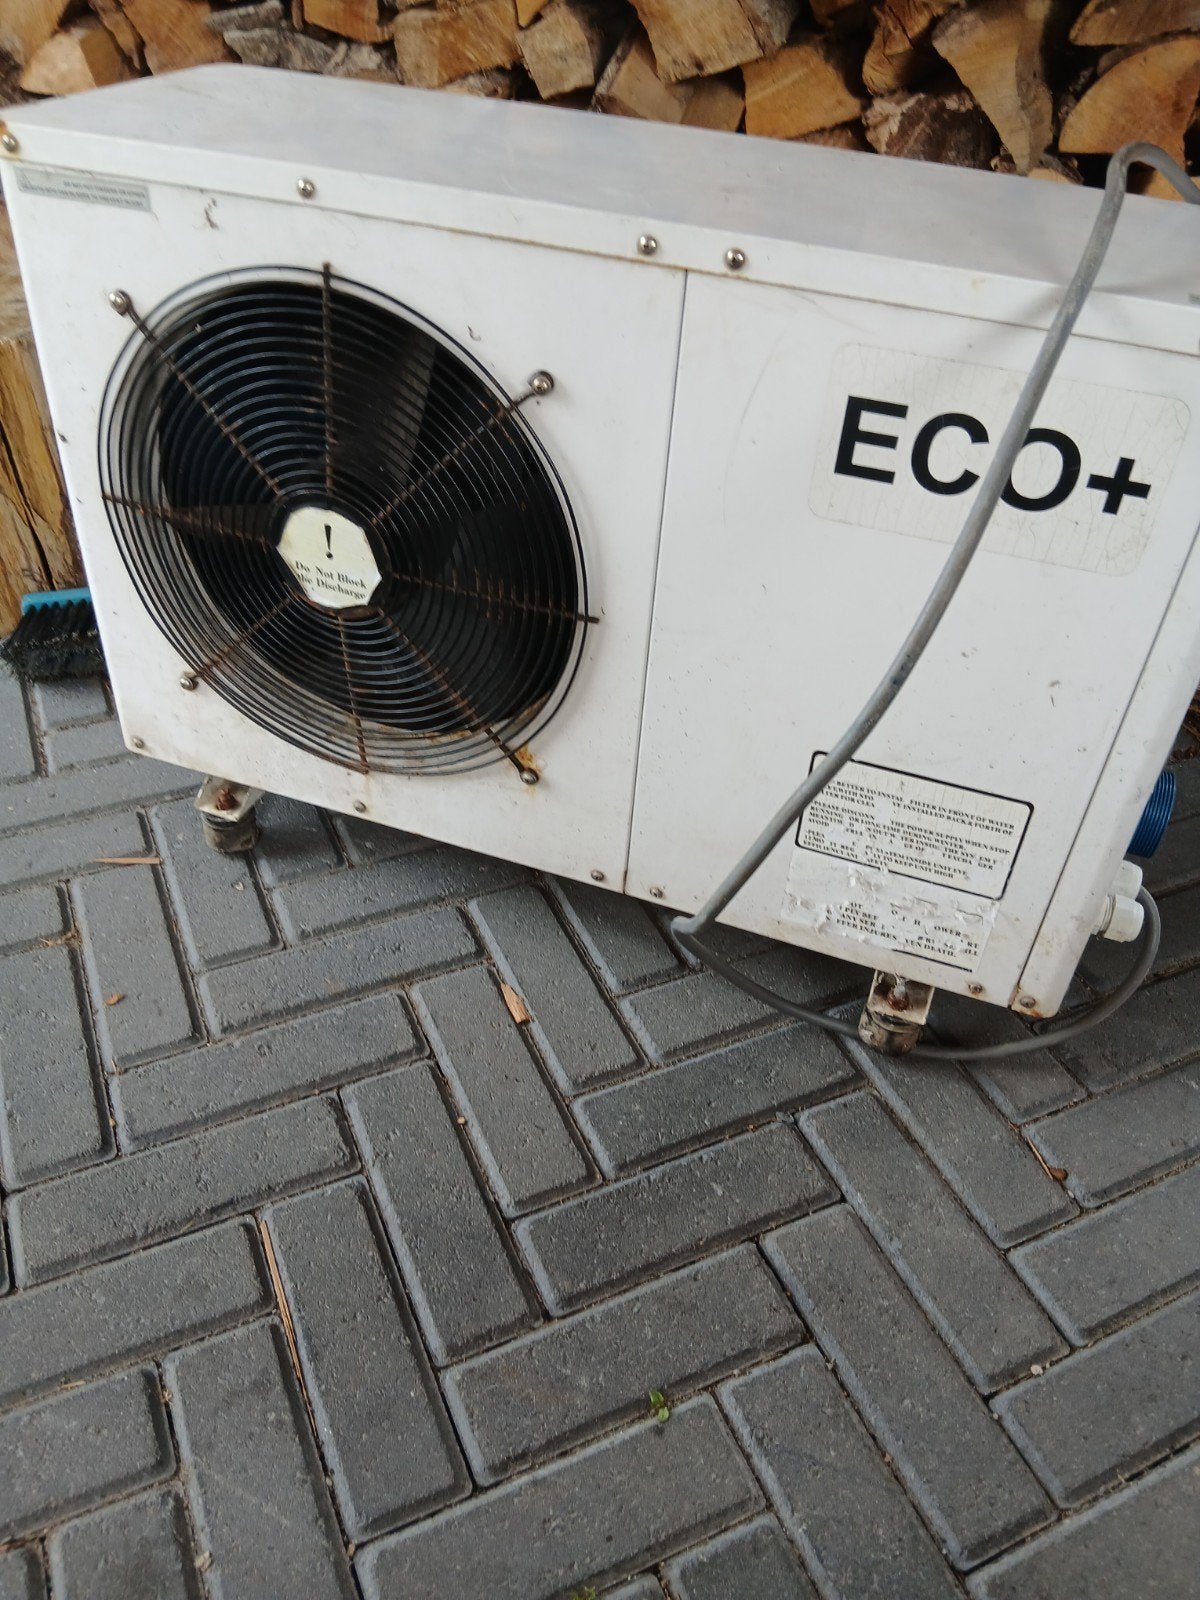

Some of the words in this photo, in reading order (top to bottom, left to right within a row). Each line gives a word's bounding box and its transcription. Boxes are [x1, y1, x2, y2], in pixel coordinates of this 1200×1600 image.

[834, 395, 1152, 515] ECO+
[315, 565, 334, 581] Not
[337, 571, 367, 589] Block
[316, 577, 366, 600] Discharge
[836, 780, 865, 792] BETTER
[909, 799, 937, 810] FILTER
[947, 808, 974, 819] FRONT
[987, 818, 1014, 829] WATER
[837, 787, 857, 796] WITH
[902, 804, 945, 818] INSTALLED
[945, 814, 966, 824] BACK
[973, 822, 1001, 833] FORTH
[840, 794, 855, 802] FOR
[809, 806, 843, 818] RUNNING
[860, 819, 881, 828] LONG
[882, 824, 900, 833] TIME
[902, 829, 932, 841] DURING
[807, 817, 829, 826] AVOID
[946, 853, 994, 869] EXCHAGER
[889, 832, 914, 842] WTER
[943, 846, 958, 854] THE
[960, 850, 991, 862] SYSEM
[906, 824, 934, 835] POWER
[935, 831, 962, 842] SUPPLY
[963, 838, 988, 849] WHEN
[989, 845, 1010, 854] STOP
[802, 840, 844, 854] EFFICIENCY
[867, 857, 887, 866] AFETY
[875, 847, 904, 858] SYSTEM
[905, 855, 931, 866] INSIDE
[932, 862, 951, 871] UNIT
[893, 858, 914, 867] KEEP
[913, 863, 932, 872] UNIT
[933, 868, 955, 878] HIGH
[858, 925, 897, 940] INJURES
[903, 938, 922, 947] VEN
[933, 925, 961, 936] OWER
